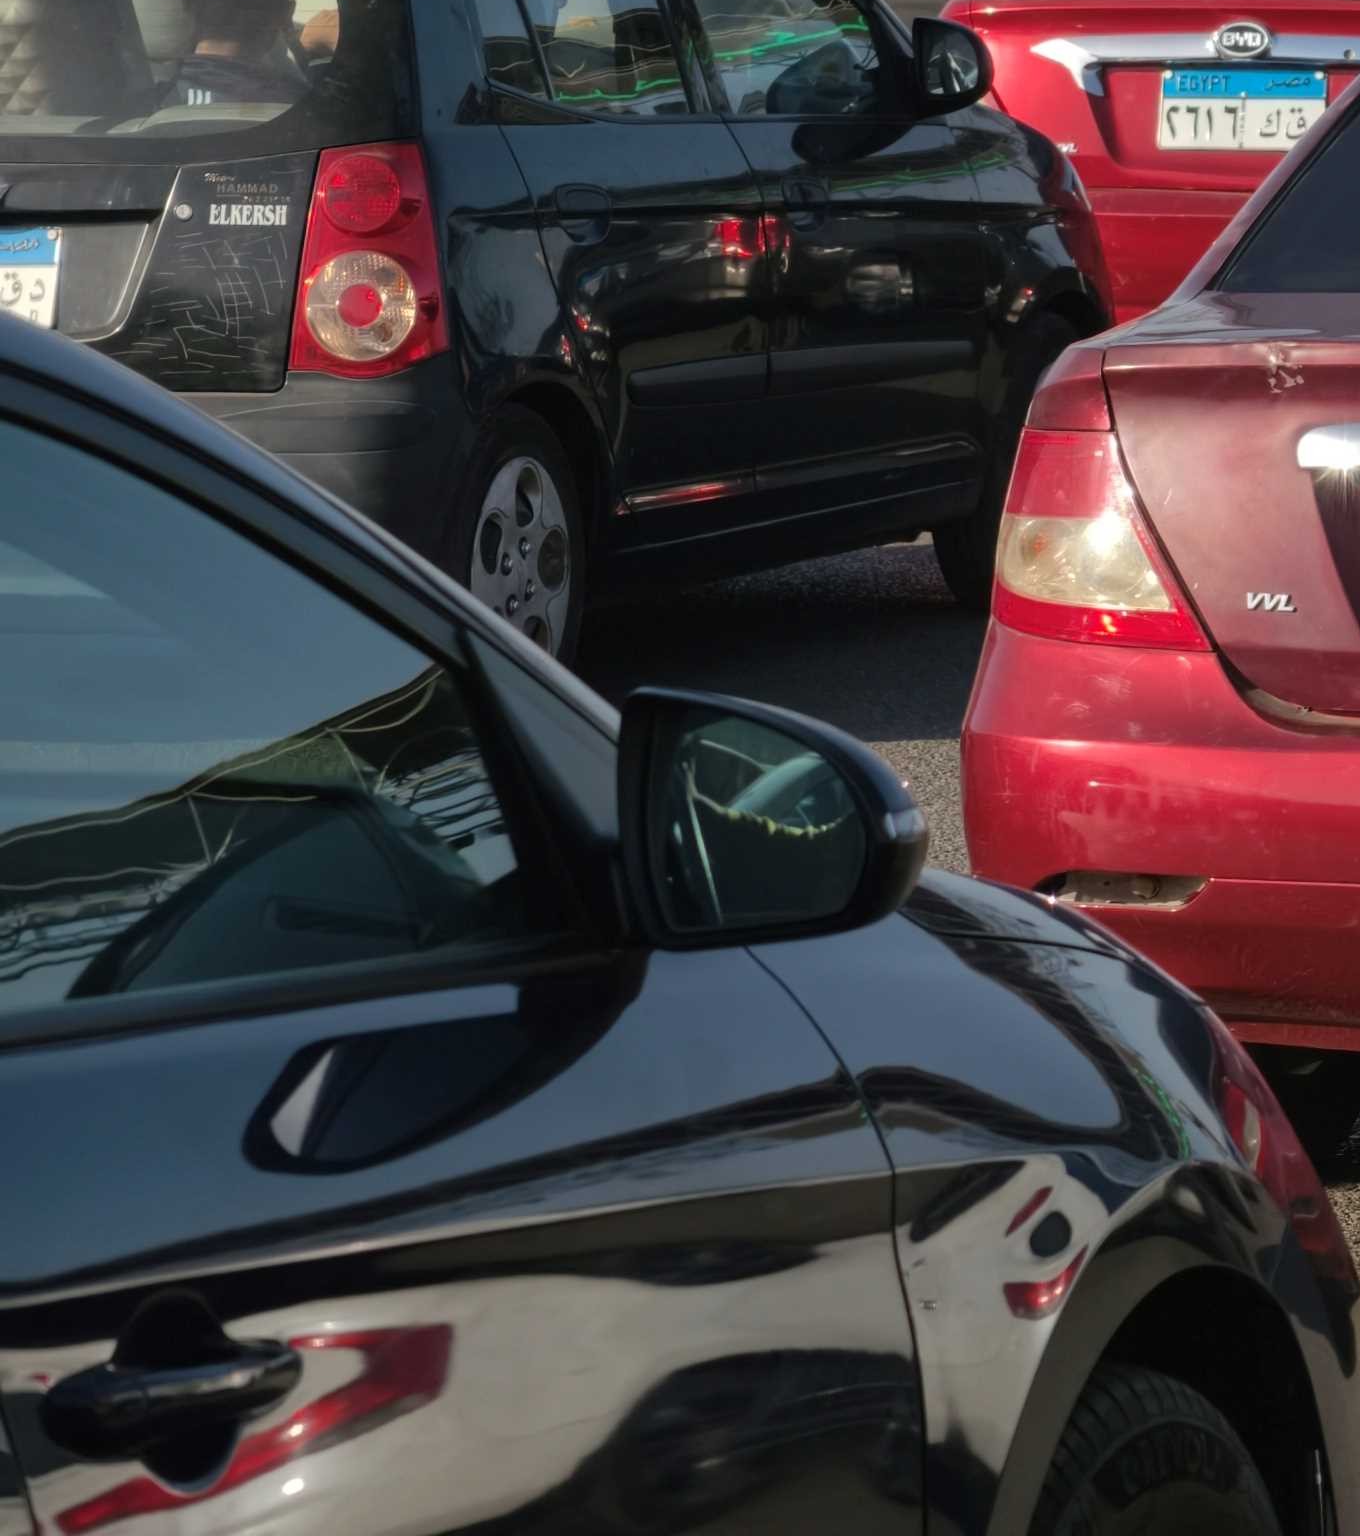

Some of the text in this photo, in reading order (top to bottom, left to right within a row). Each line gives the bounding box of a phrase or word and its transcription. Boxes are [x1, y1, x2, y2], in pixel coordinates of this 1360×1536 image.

[1222, 32, 1261, 47] BYD
[1178, 74, 1231, 92] EGYPT
[216, 184, 279, 193] HAMMAD
[208, 204, 288, 225] ELKERSH
[1247, 592, 1297, 612] VVL
